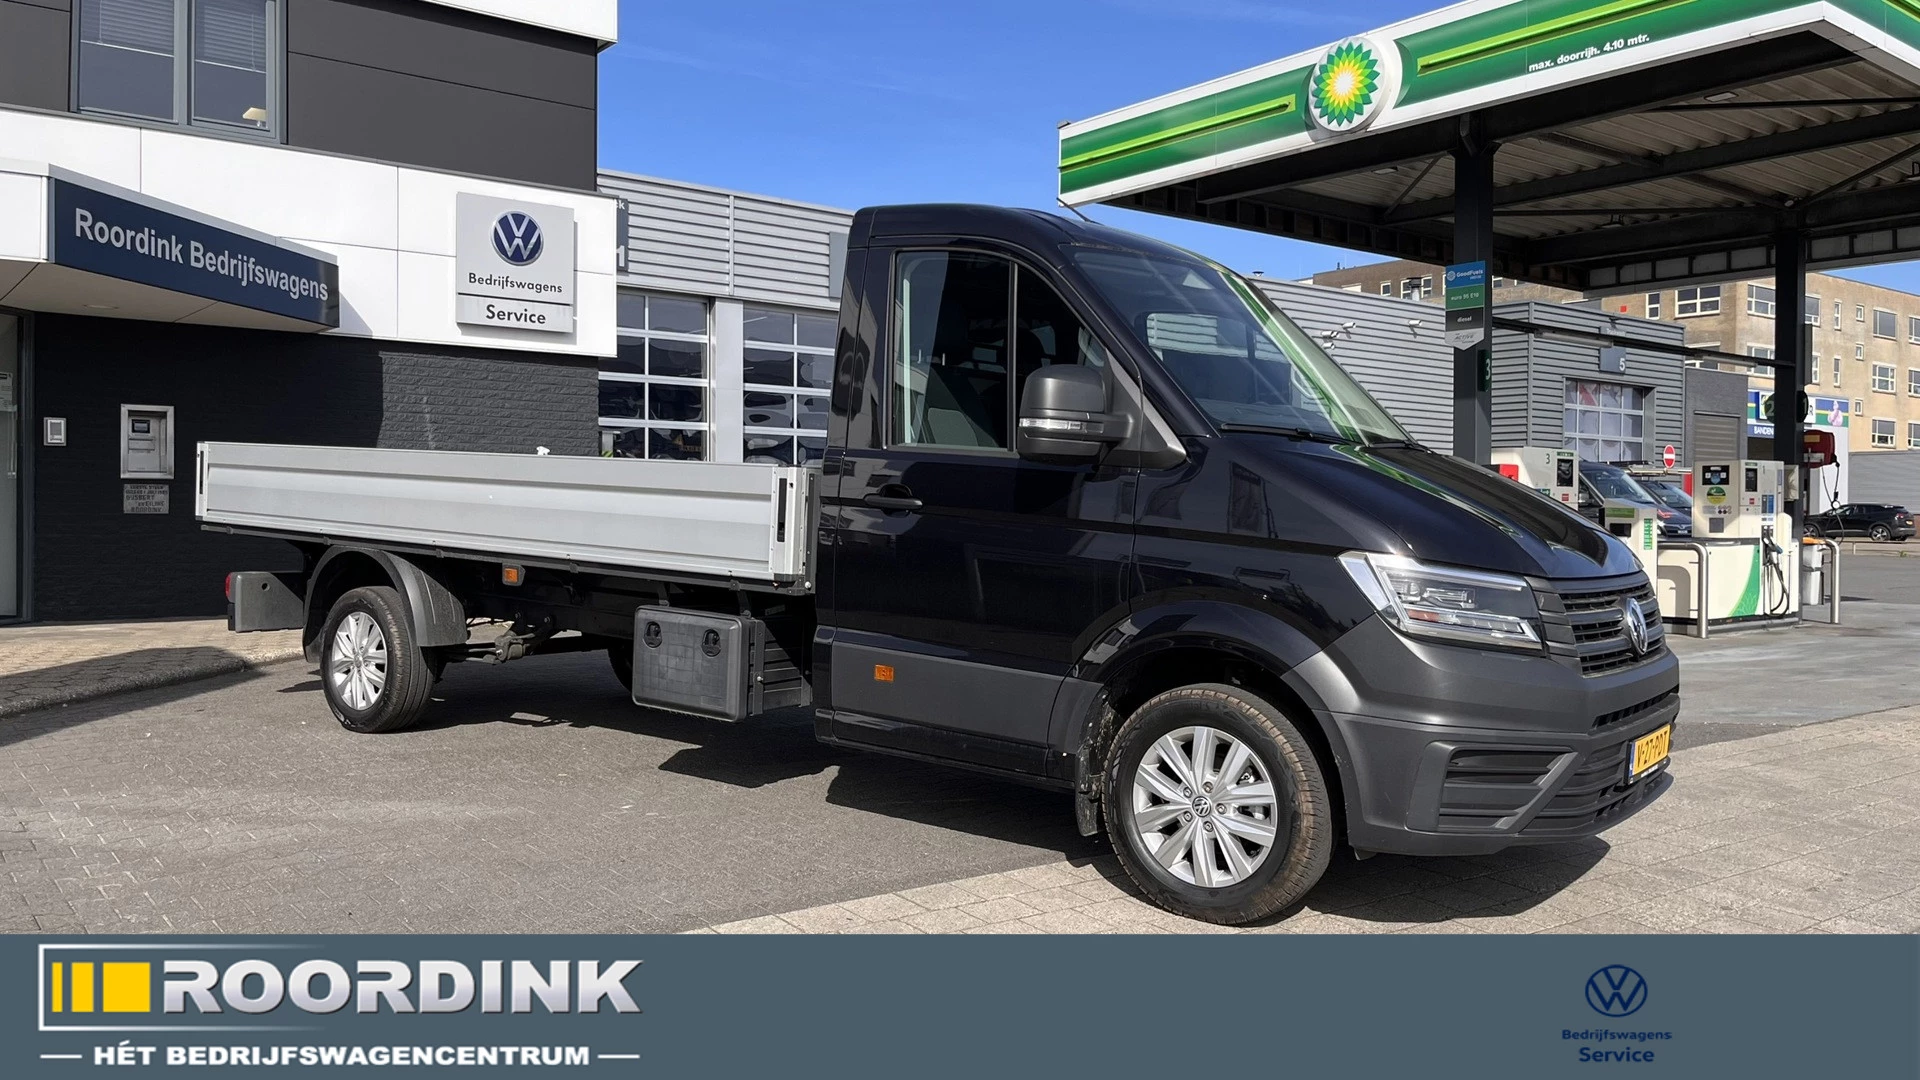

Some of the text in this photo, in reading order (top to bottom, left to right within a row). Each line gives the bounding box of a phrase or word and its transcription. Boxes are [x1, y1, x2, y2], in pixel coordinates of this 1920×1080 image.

[1528, 34, 1650, 72] max. doorrijh. 4.10 mtr.
[75, 208, 329, 301] Roordink Bedrijfswagens
[616, 245, 625, 267] 1
[468, 272, 563, 293] Bedrijfswagens
[486, 304, 546, 324] Service
[1485, 358, 1491, 380] 3
[1619, 357, 1626, 371] 5
[1767, 401, 1775, 417] 2
